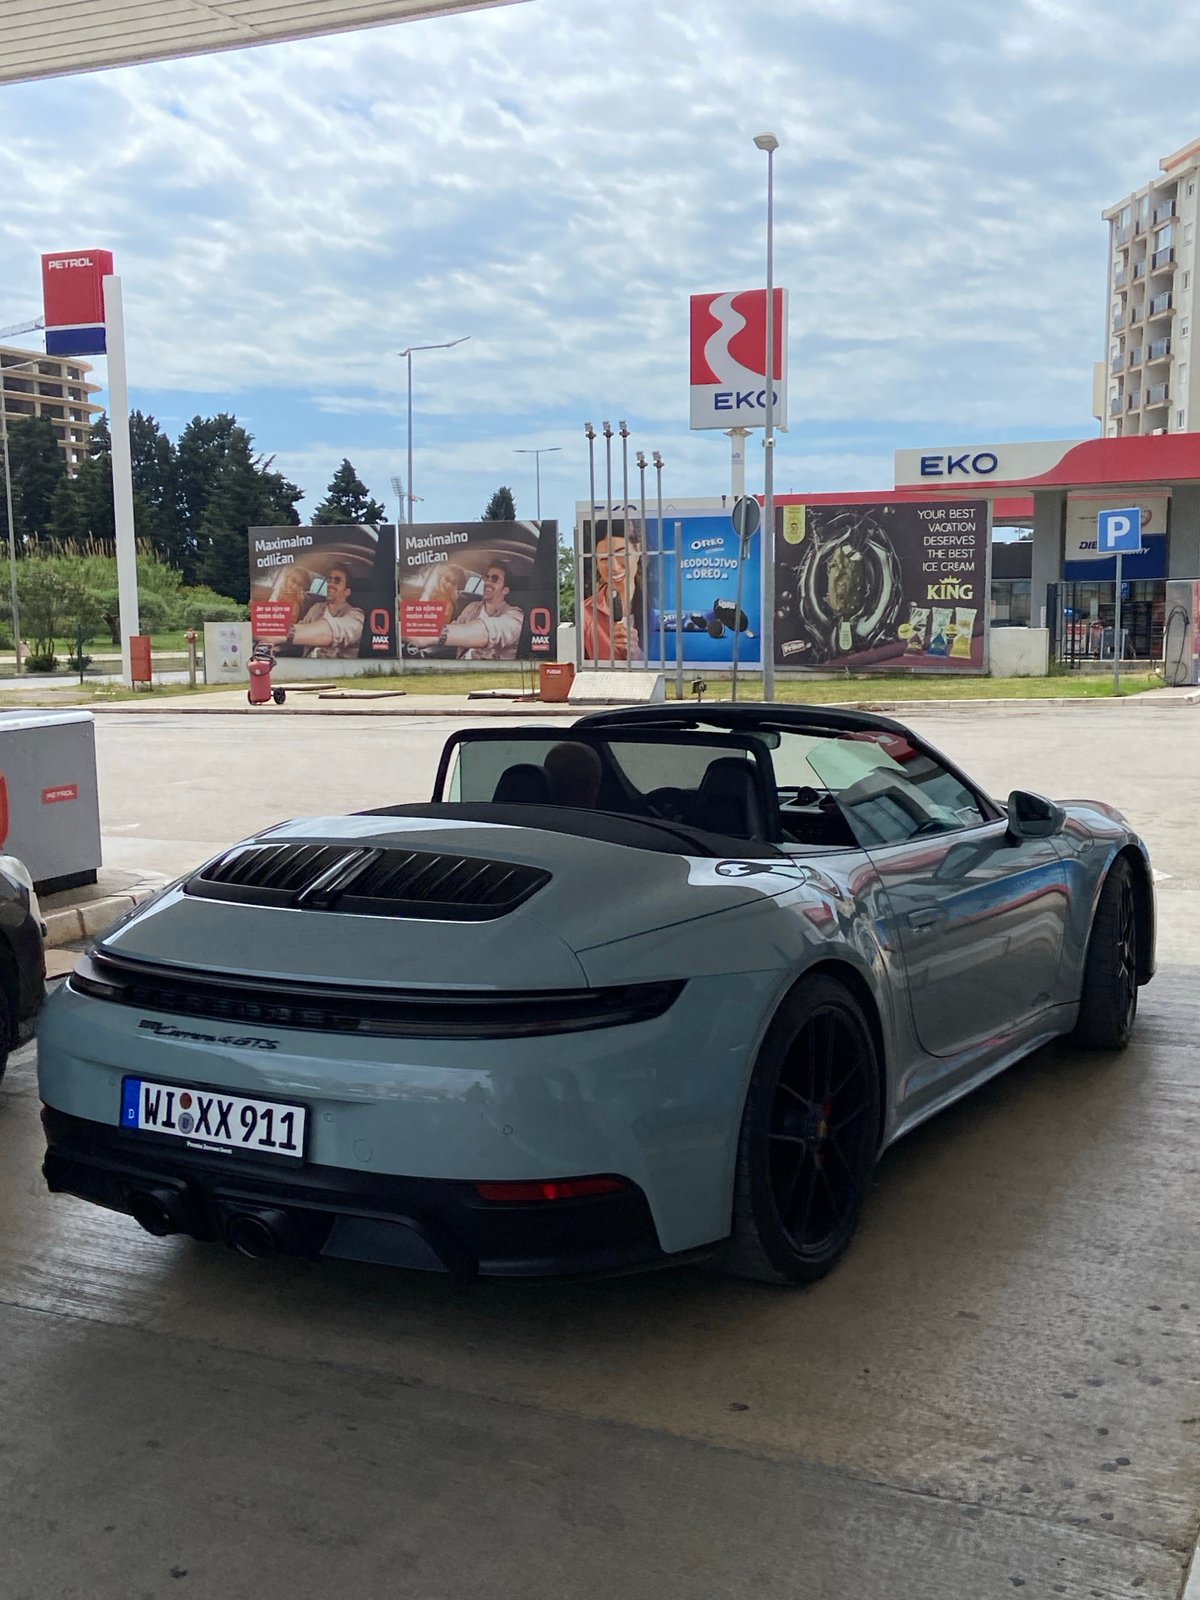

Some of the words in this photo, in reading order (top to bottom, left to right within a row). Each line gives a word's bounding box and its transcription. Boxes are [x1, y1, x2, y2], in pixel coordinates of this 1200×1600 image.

[48, 257, 94, 270] PETROL
[714, 389, 778, 411] EKO
[920, 452, 998, 476] EKO
[917, 509, 946, 519] YOUR
[949, 508, 976, 518] BEST
[928, 522, 976, 532] VACATION
[1107, 516, 1131, 547] P
[255, 535, 313, 552] Maximalno
[405, 531, 469, 550] Maximalno
[690, 537, 724, 551] OREO
[923, 535, 976, 546] DESERVES
[256, 553, 294, 568] odličan
[407, 550, 449, 566] odličan
[927, 549, 946, 558] THE
[948, 548, 975, 558] BEST
[693, 569, 721, 579] OREO
[922, 562, 939, 571] ICE
[940, 562, 975, 572] CREAM
[927, 584, 974, 600] KING
[370, 608, 390, 635] Q
[529, 607, 551, 635] Q
[531, 636, 550, 644] MAX
[46, 789, 75, 799] PETROL
[127, 1108, 136, 1120] D
[144, 1087, 176, 1129] WI
[194, 1096, 234, 1140] XX
[240, 1105, 297, 1151] 911
